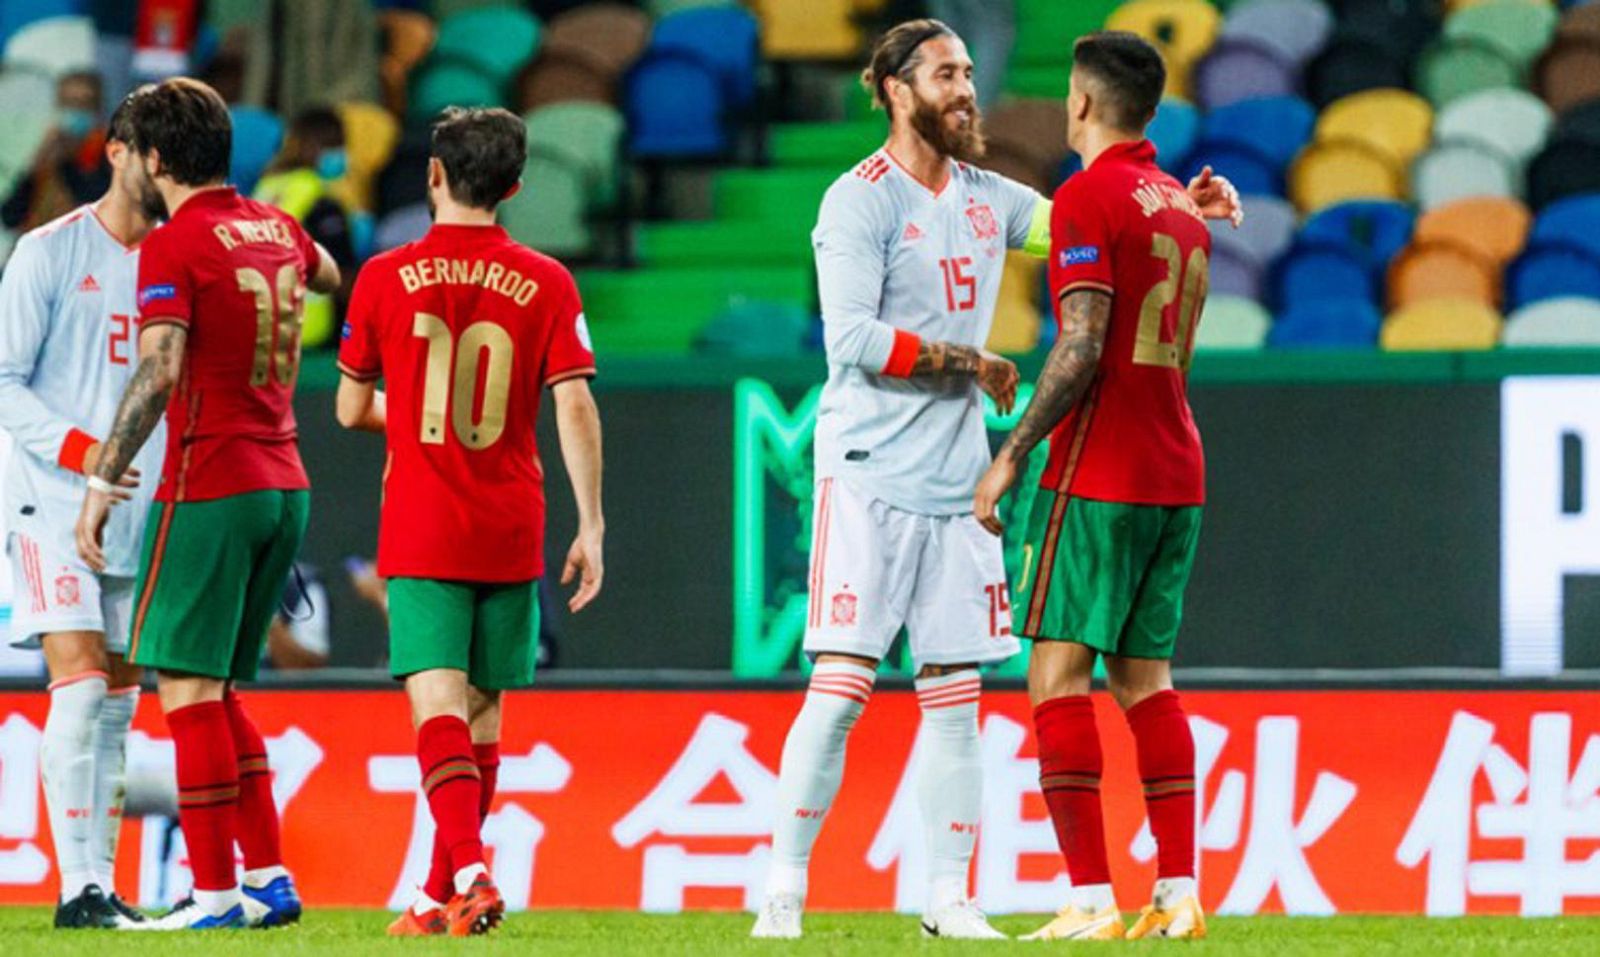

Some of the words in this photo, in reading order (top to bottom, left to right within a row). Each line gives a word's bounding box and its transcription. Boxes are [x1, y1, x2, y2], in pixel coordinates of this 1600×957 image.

[398, 256, 539, 307] BERNARDO
[939, 256, 976, 313] 15
[412, 311, 513, 450] 10
